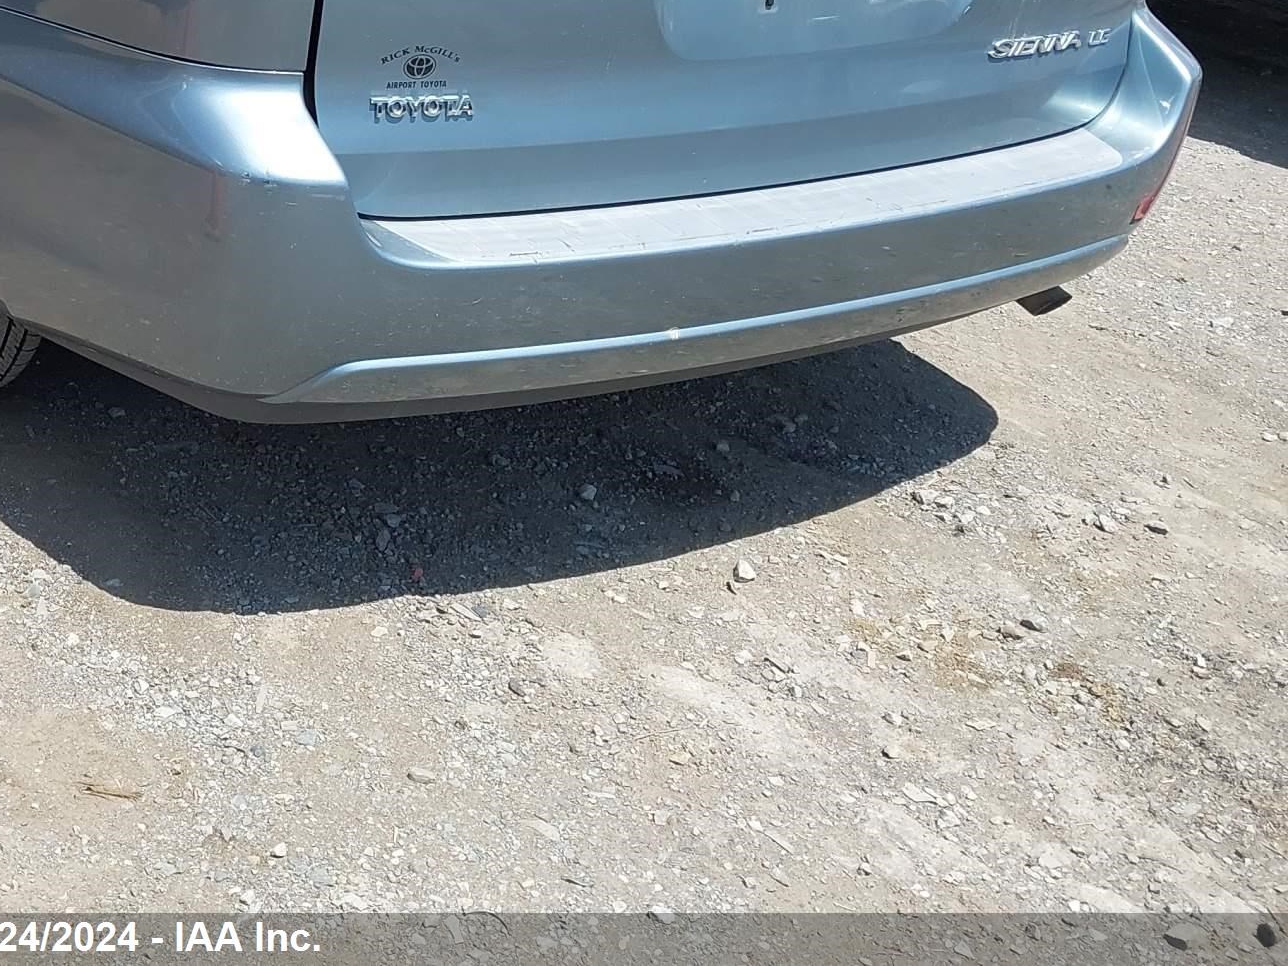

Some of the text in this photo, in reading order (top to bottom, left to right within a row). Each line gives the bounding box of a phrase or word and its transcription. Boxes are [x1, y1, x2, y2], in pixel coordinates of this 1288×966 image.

[988, 28, 1112, 59] SIENNA LE
[380, 47, 411, 65] RICK
[386, 80, 448, 90] AIRPORT TOYOTA
[369, 94, 474, 121] TOYOTA
